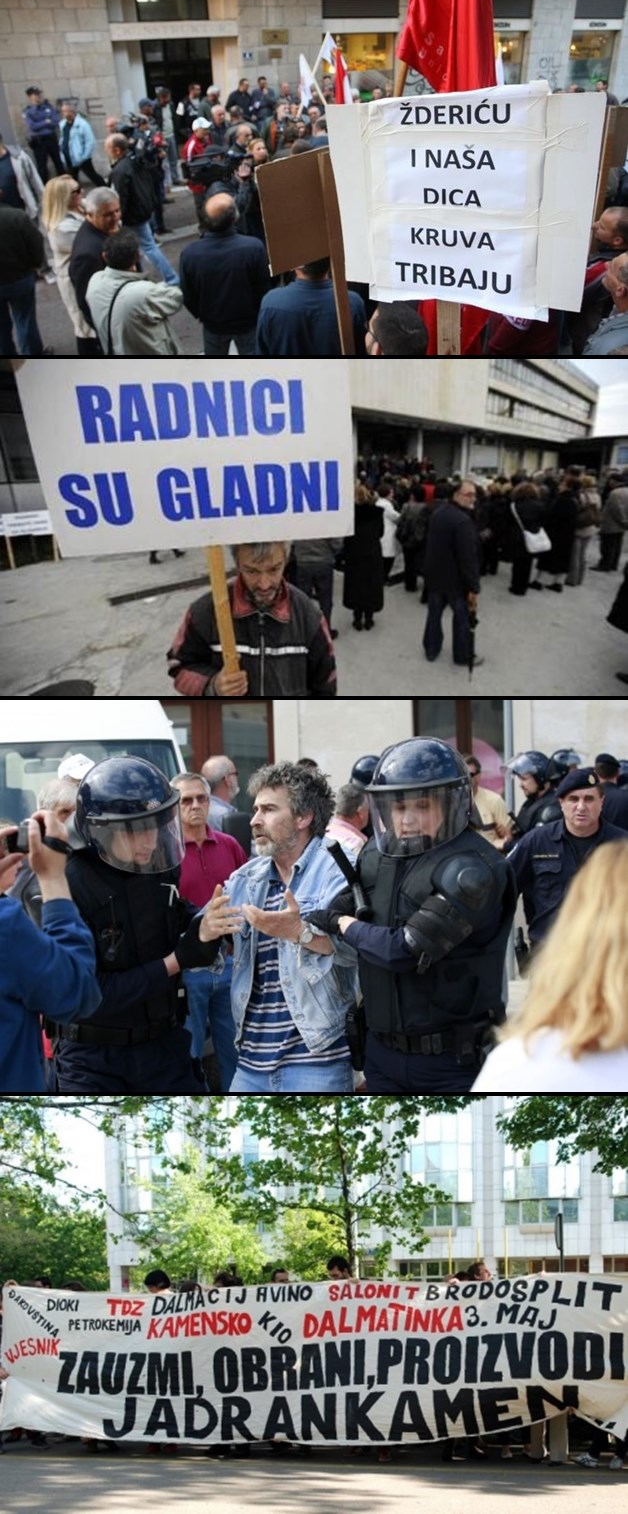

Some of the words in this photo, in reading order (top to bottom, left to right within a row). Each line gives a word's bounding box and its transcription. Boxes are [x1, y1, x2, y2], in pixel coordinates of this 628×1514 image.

[400, 99, 512, 126] ŽDERIĆU
[410, 149, 416, 169] I
[425, 144, 496, 171] NAŠA
[423, 187, 482, 209] DICA
[410, 226, 495, 252] KRUVA
[395, 261, 513, 295] TRIBAJU
[75, 378, 306, 444] RADNICI
[57, 472, 134, 528] SU
[156, 460, 340, 522] GLADNI
[47, 1298, 79, 1312] DIOKI
[107, 1298, 146, 1316] TDZ
[329, 1284, 420, 1302] SALONIT
[425, 1279, 622, 1310] BRODOSPLIT
[68, 1318, 142, 1336] PETROKEMIJA
[146, 1311, 253, 1340] KAMENSKO
[257, 1310, 292, 1344] KIO
[303, 1302, 464, 1339] DALMATINKA
[464, 1306, 488, 1327] 3.
[496, 1302, 557, 1330] MAJ
[57, 1350, 203, 1399] ZAUZMI,
[377, 1331, 625, 1385] PROIZVODI
[103, 1385, 579, 1440] JADRANKAMEN
